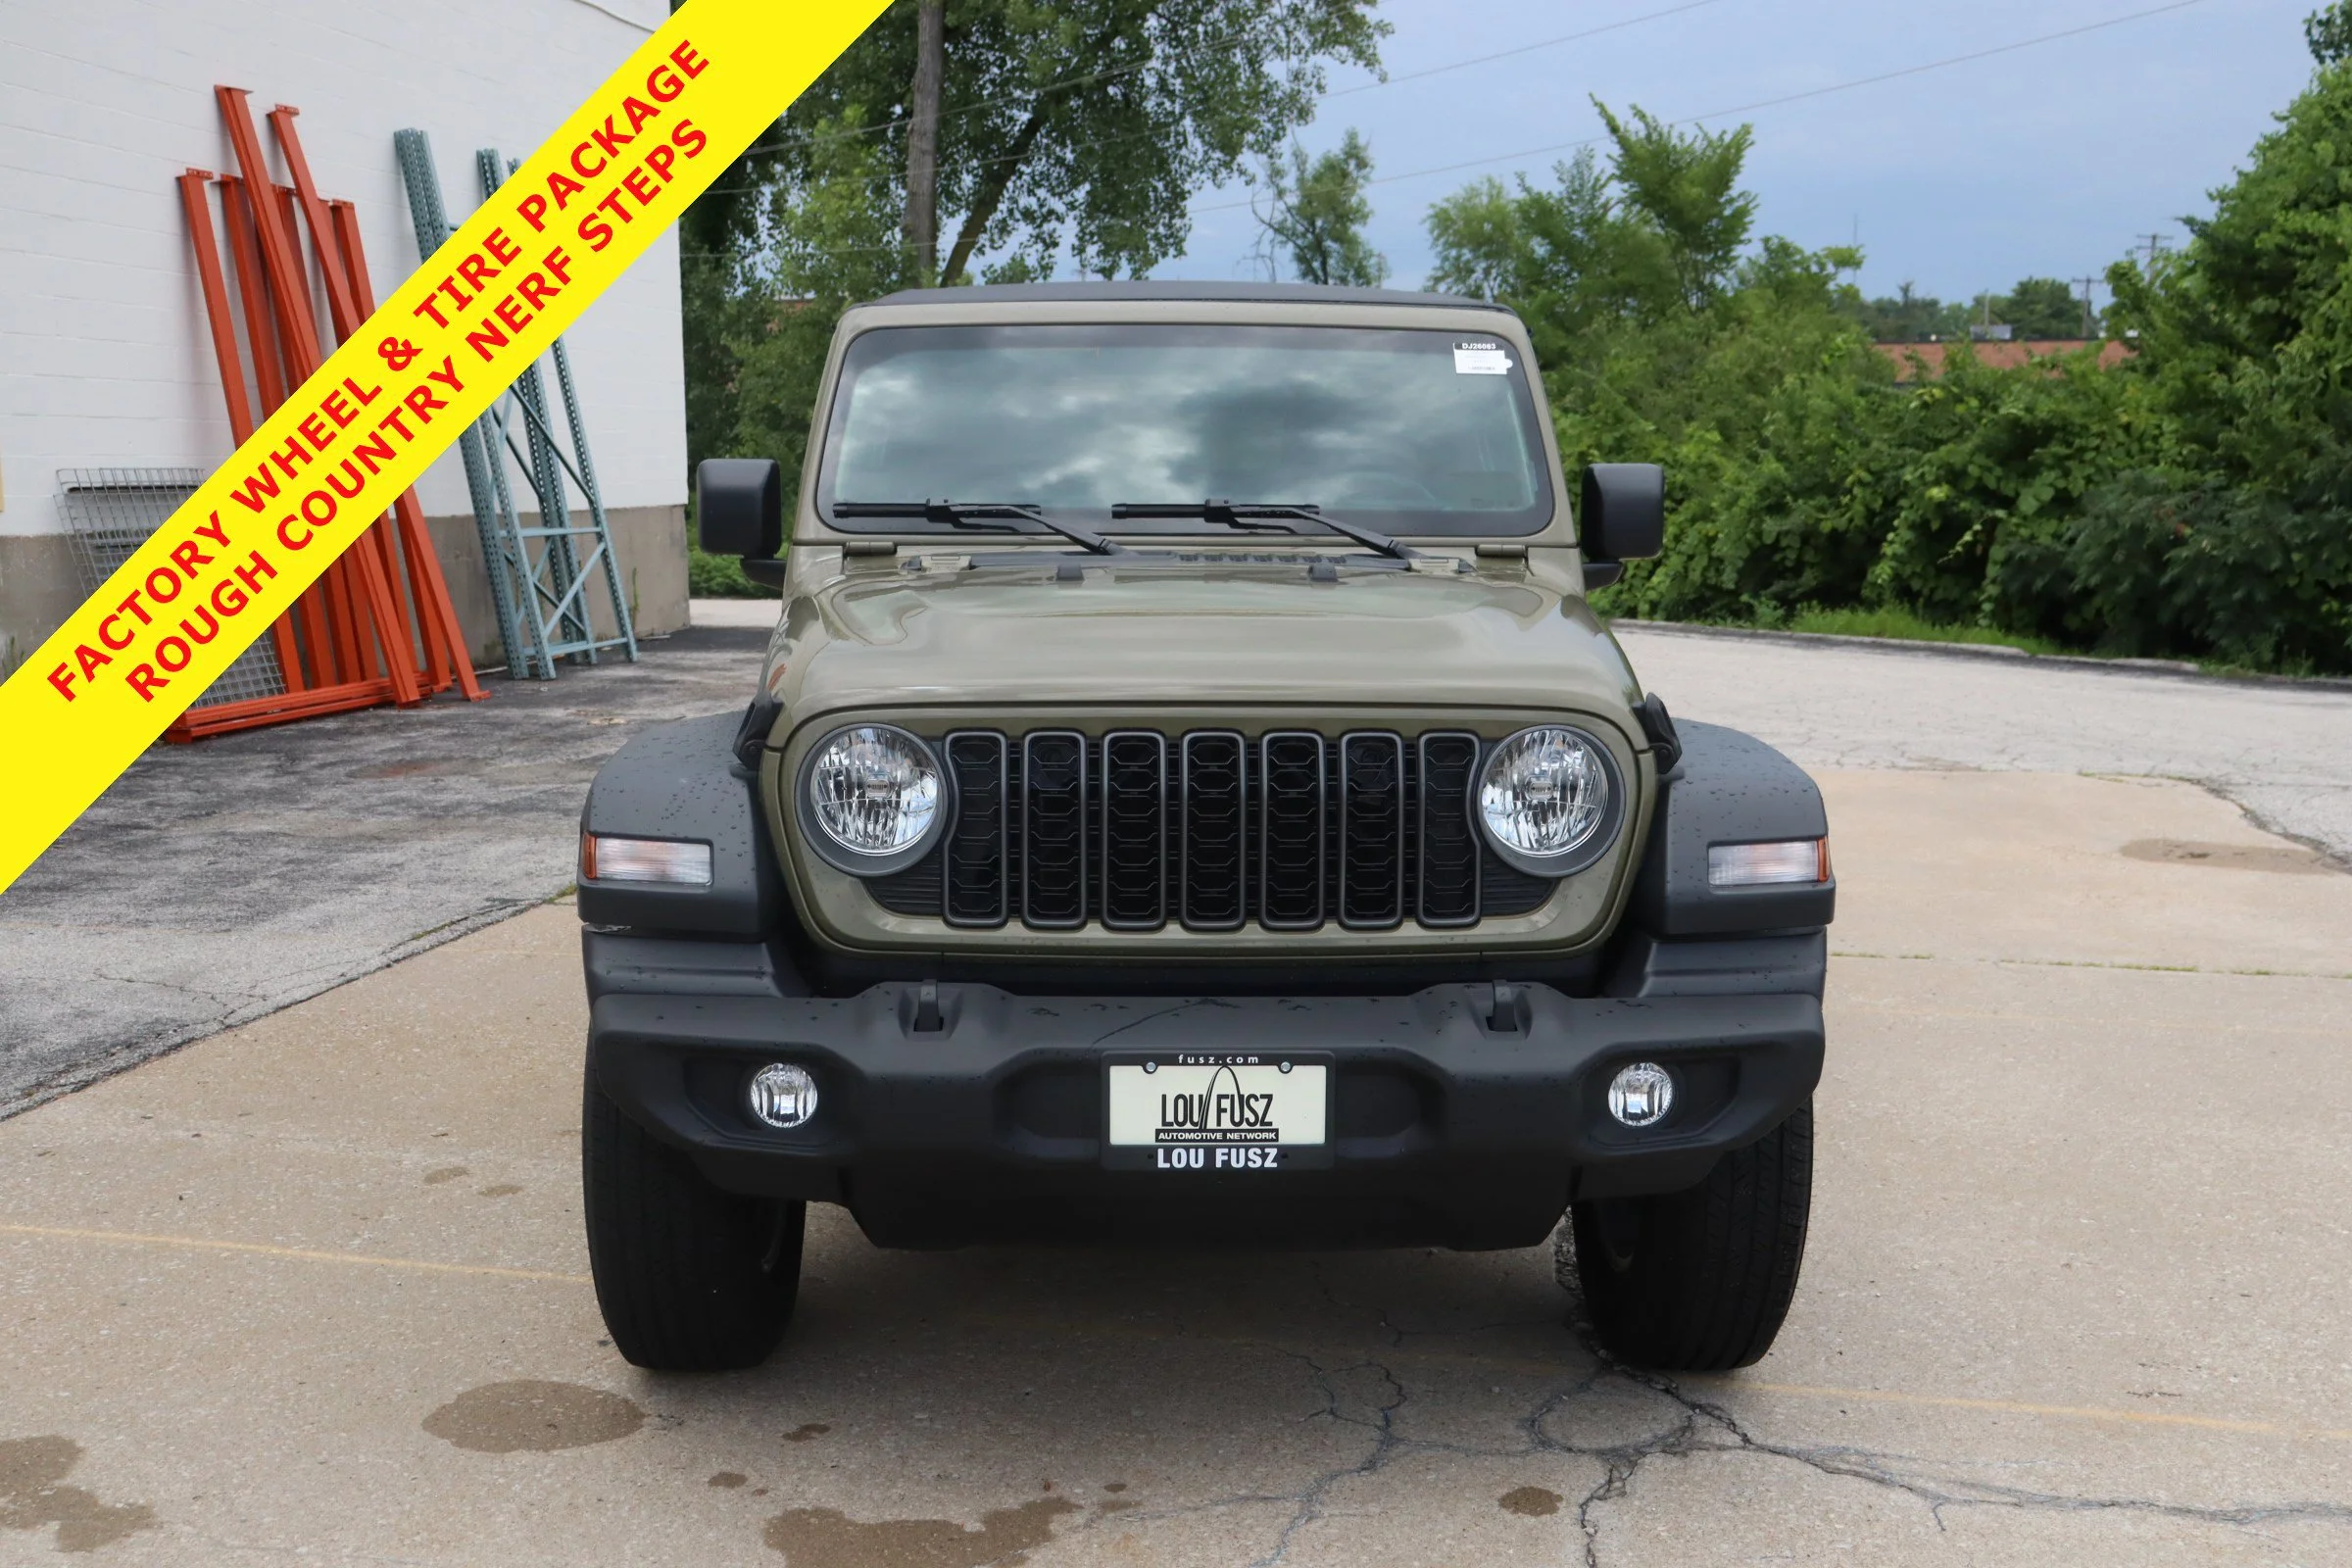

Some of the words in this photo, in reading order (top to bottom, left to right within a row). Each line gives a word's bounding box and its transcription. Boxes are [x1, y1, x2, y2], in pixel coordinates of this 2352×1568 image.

[1178, 1054, 1259, 1064] fusz.com
[1161, 1094, 1203, 1127] LOU
[1216, 1094, 1273, 1127] FUSZ
[1157, 1148, 1204, 1168] LOU
[1215, 1148, 1278, 1168] FUSZ
